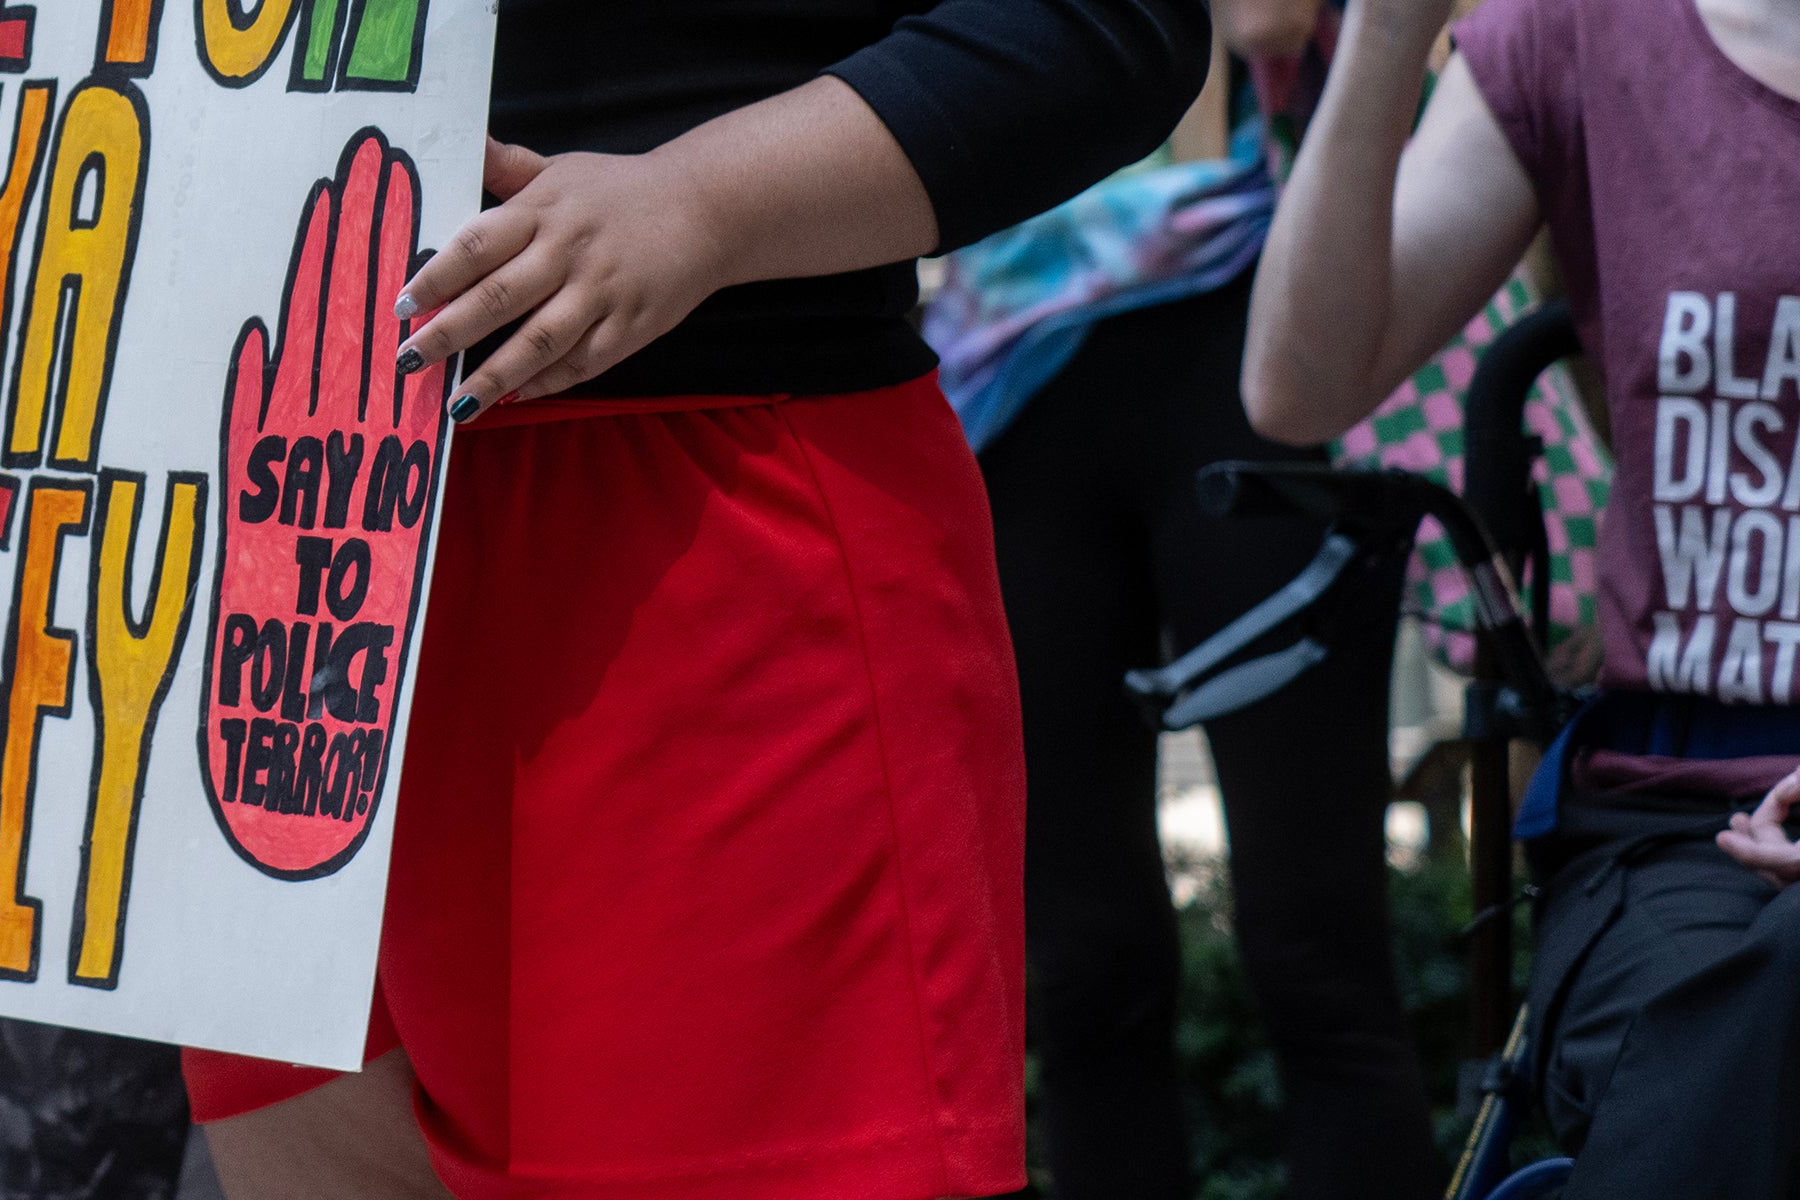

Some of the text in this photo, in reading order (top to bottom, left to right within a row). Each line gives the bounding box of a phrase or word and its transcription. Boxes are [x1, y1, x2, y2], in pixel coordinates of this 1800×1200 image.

[239, 429, 430, 532] SAY NO
[296, 535, 371, 621] TO
[218, 613, 393, 723] POLICE
[220, 717, 384, 822] TERROR!
